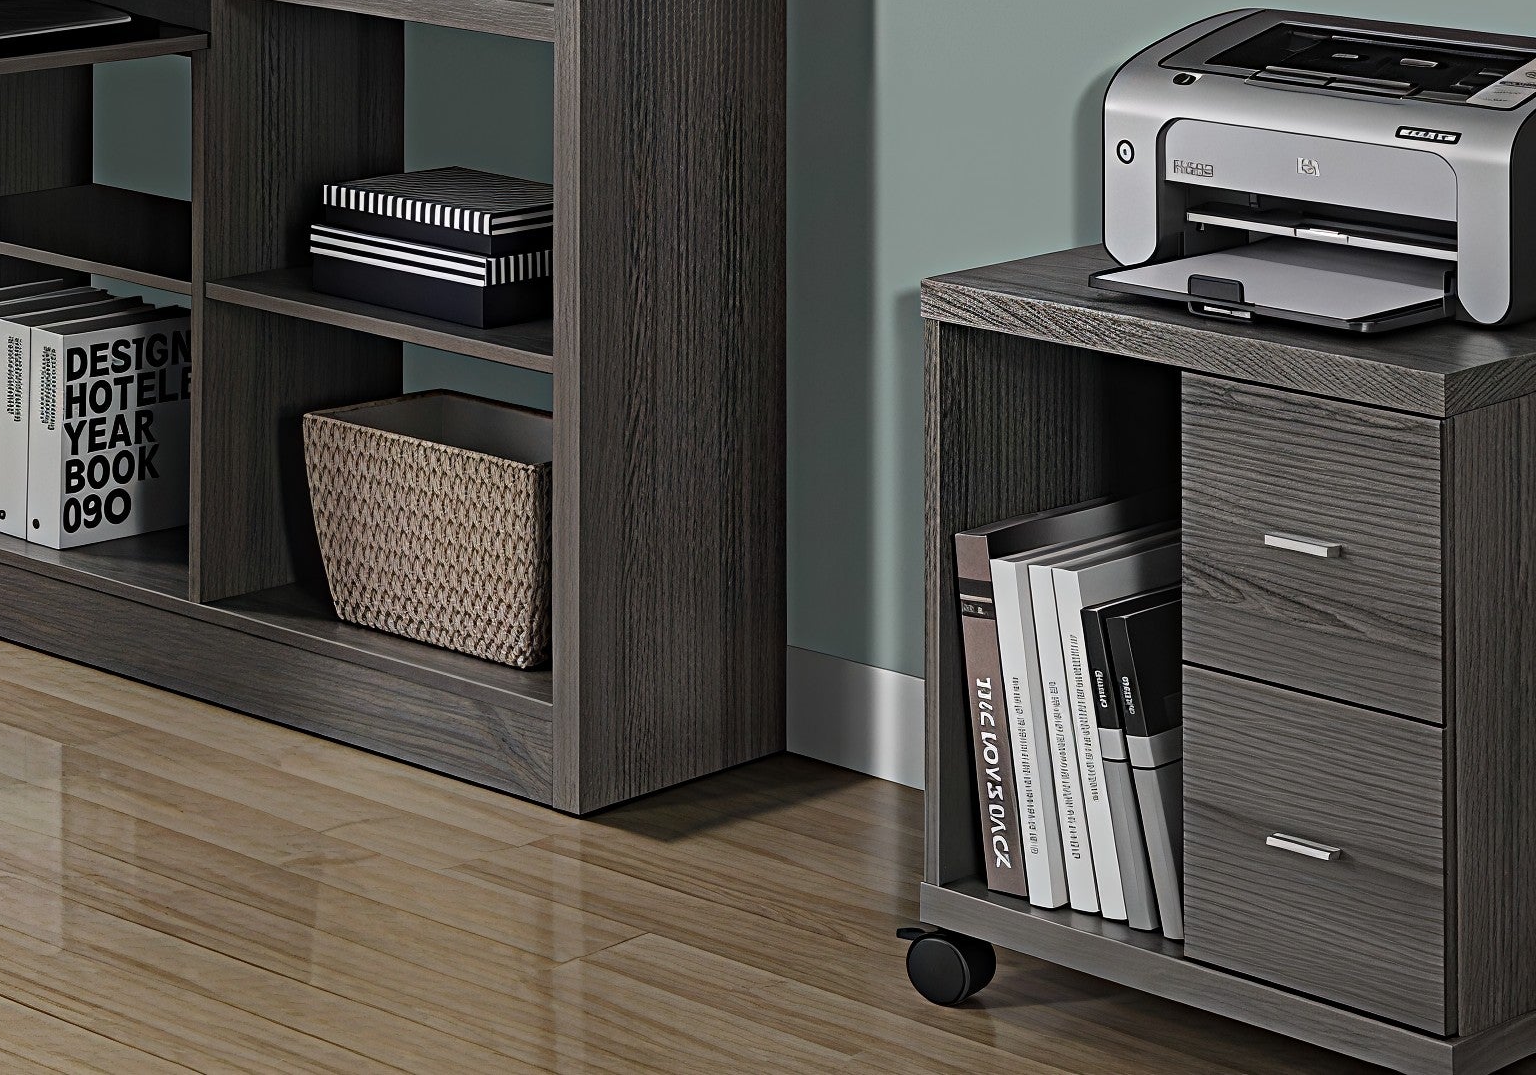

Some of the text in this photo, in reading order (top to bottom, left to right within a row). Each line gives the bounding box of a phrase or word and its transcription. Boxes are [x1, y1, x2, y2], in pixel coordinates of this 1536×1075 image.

[66, 330, 192, 382] DESIGN
[63, 409, 156, 455] YEAR
[65, 443, 160, 494] BOOK
